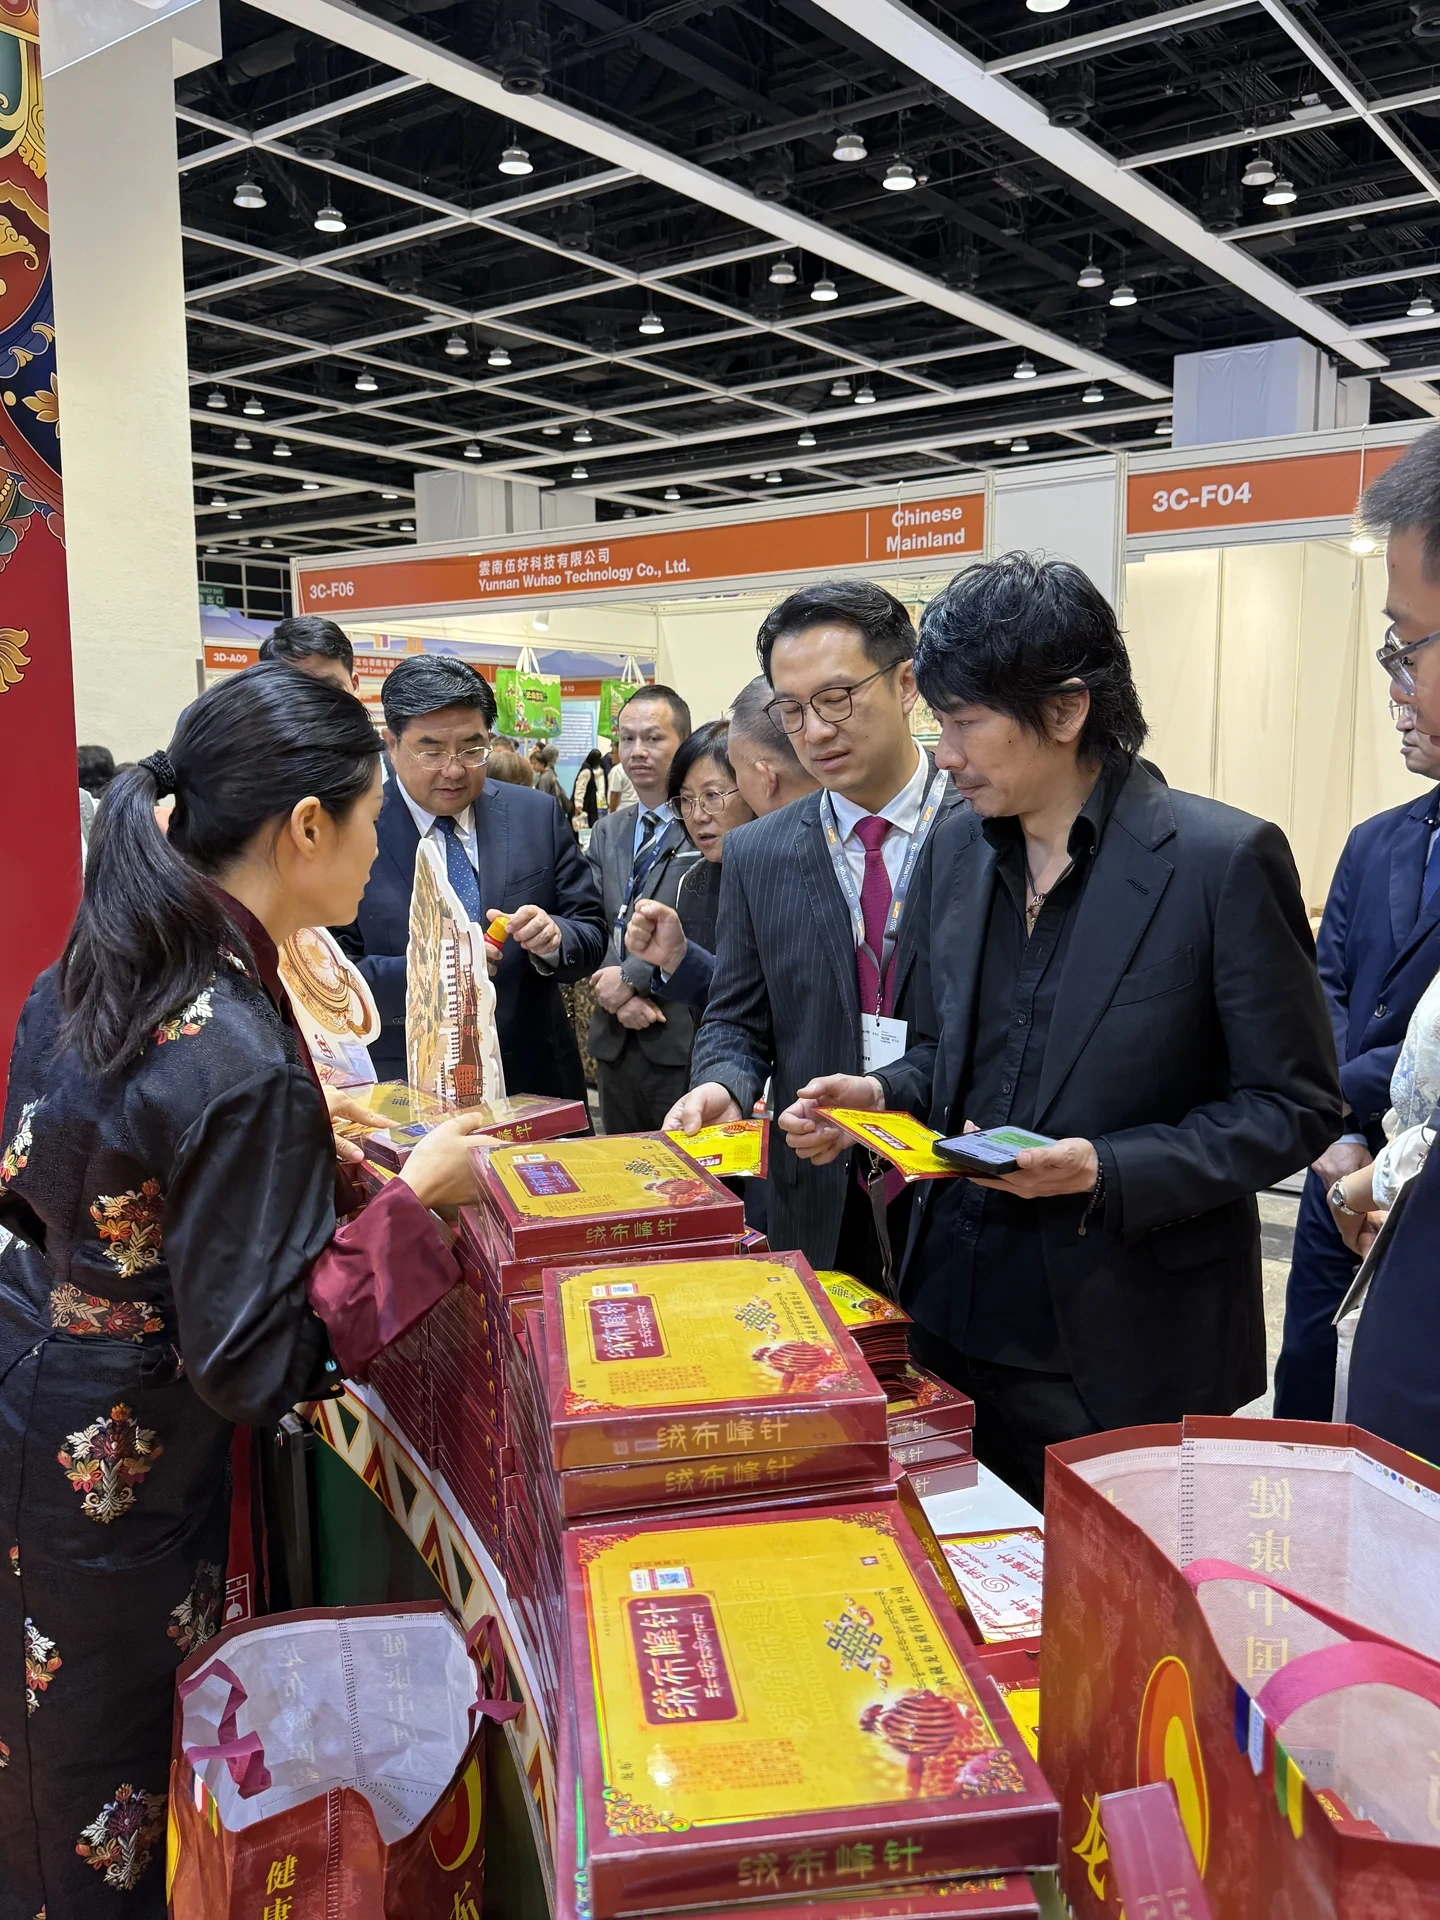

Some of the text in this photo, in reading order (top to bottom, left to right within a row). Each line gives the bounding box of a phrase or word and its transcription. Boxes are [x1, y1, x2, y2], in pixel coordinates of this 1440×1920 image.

[1151, 481, 1252, 513] 3C-F04
[891, 506, 963, 528] Chinese
[886, 527, 965, 553] Mainland
[478, 547, 610, 577] 雲南伍好科技有限公司
[478, 558, 691, 592] Yunnan Wuhao Technology Co., Ltd.
[309, 581, 355, 600] 3C-F06
[213, 652, 248, 664] 3D-A09
